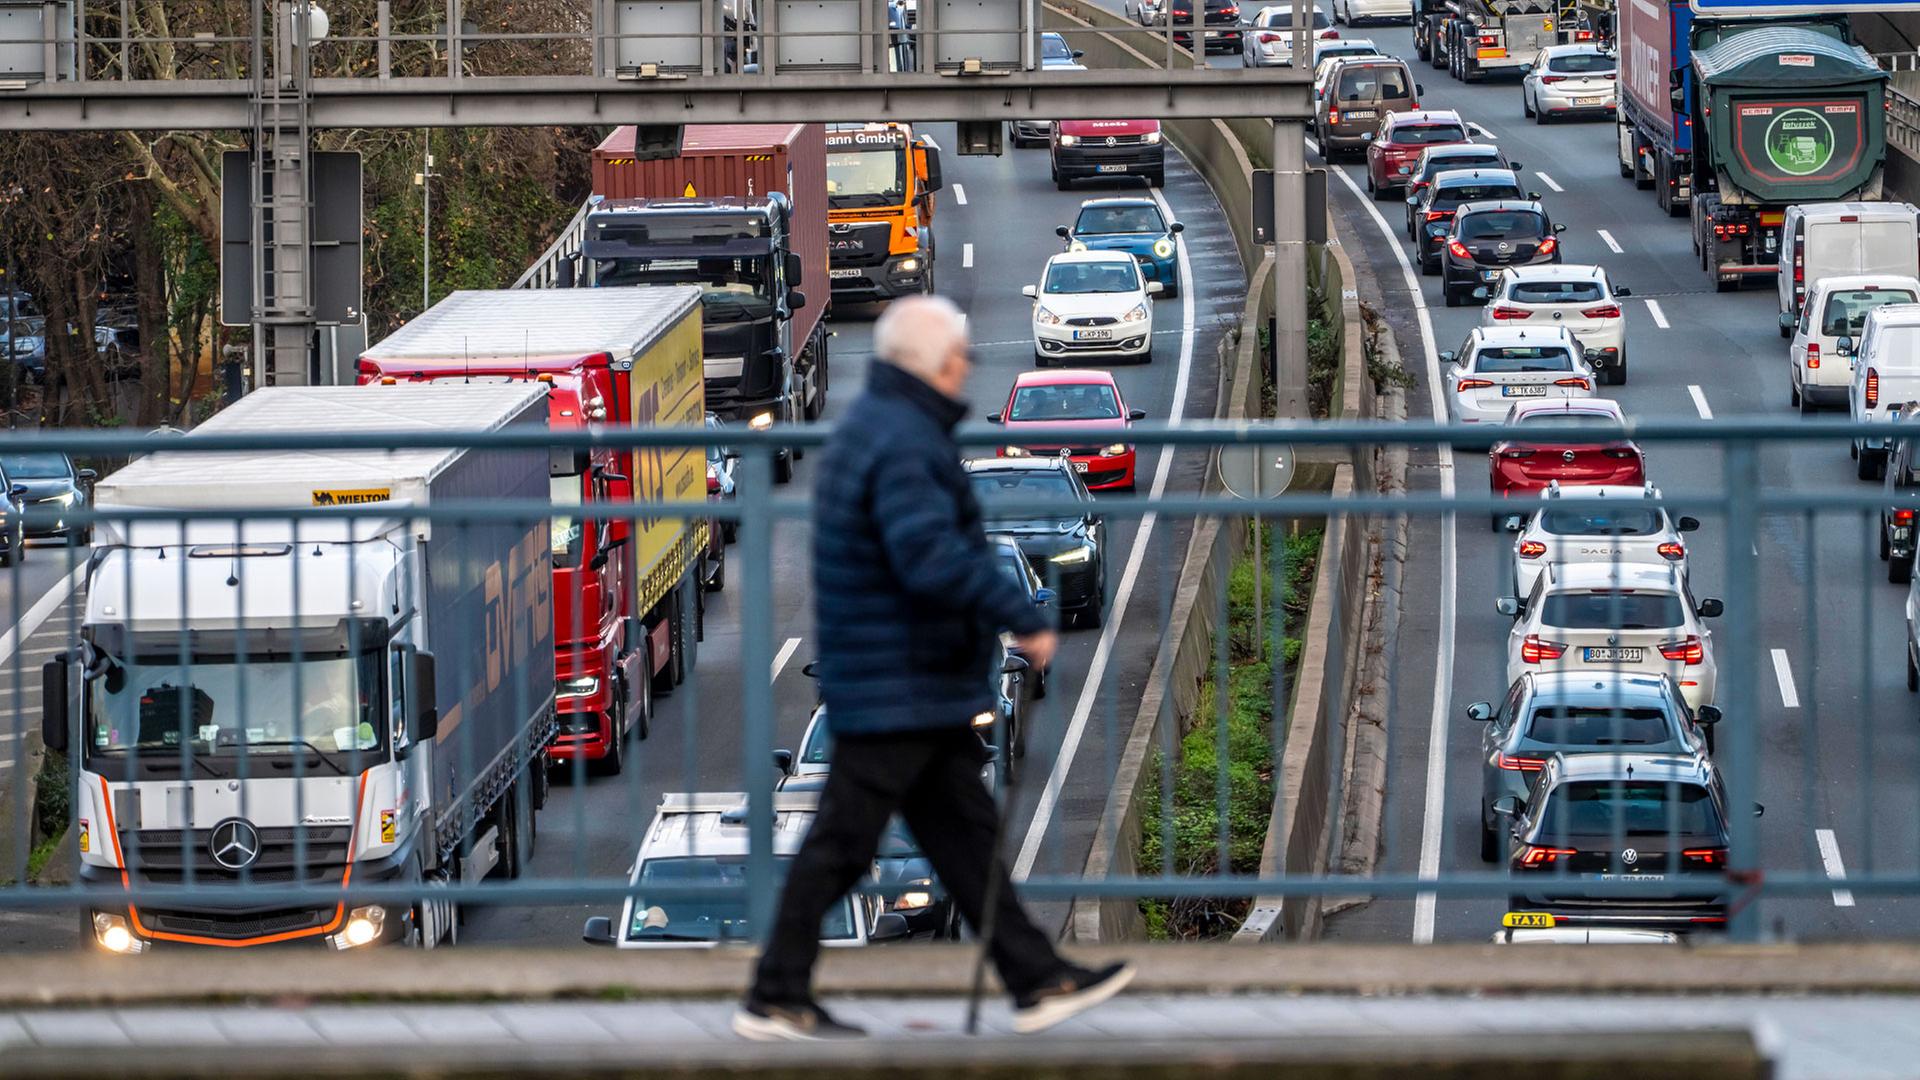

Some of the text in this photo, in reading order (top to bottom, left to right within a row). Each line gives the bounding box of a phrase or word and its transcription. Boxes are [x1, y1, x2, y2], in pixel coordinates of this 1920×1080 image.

[826, 131, 896, 145] ann GmbH
[337, 494, 390, 505] WIELTON
[1580, 547, 1622, 555] DACIA
[1590, 648, 1601, 659] BO
[1619, 648, 1640, 659] 1911
[1512, 916, 1546, 926] TAXI
